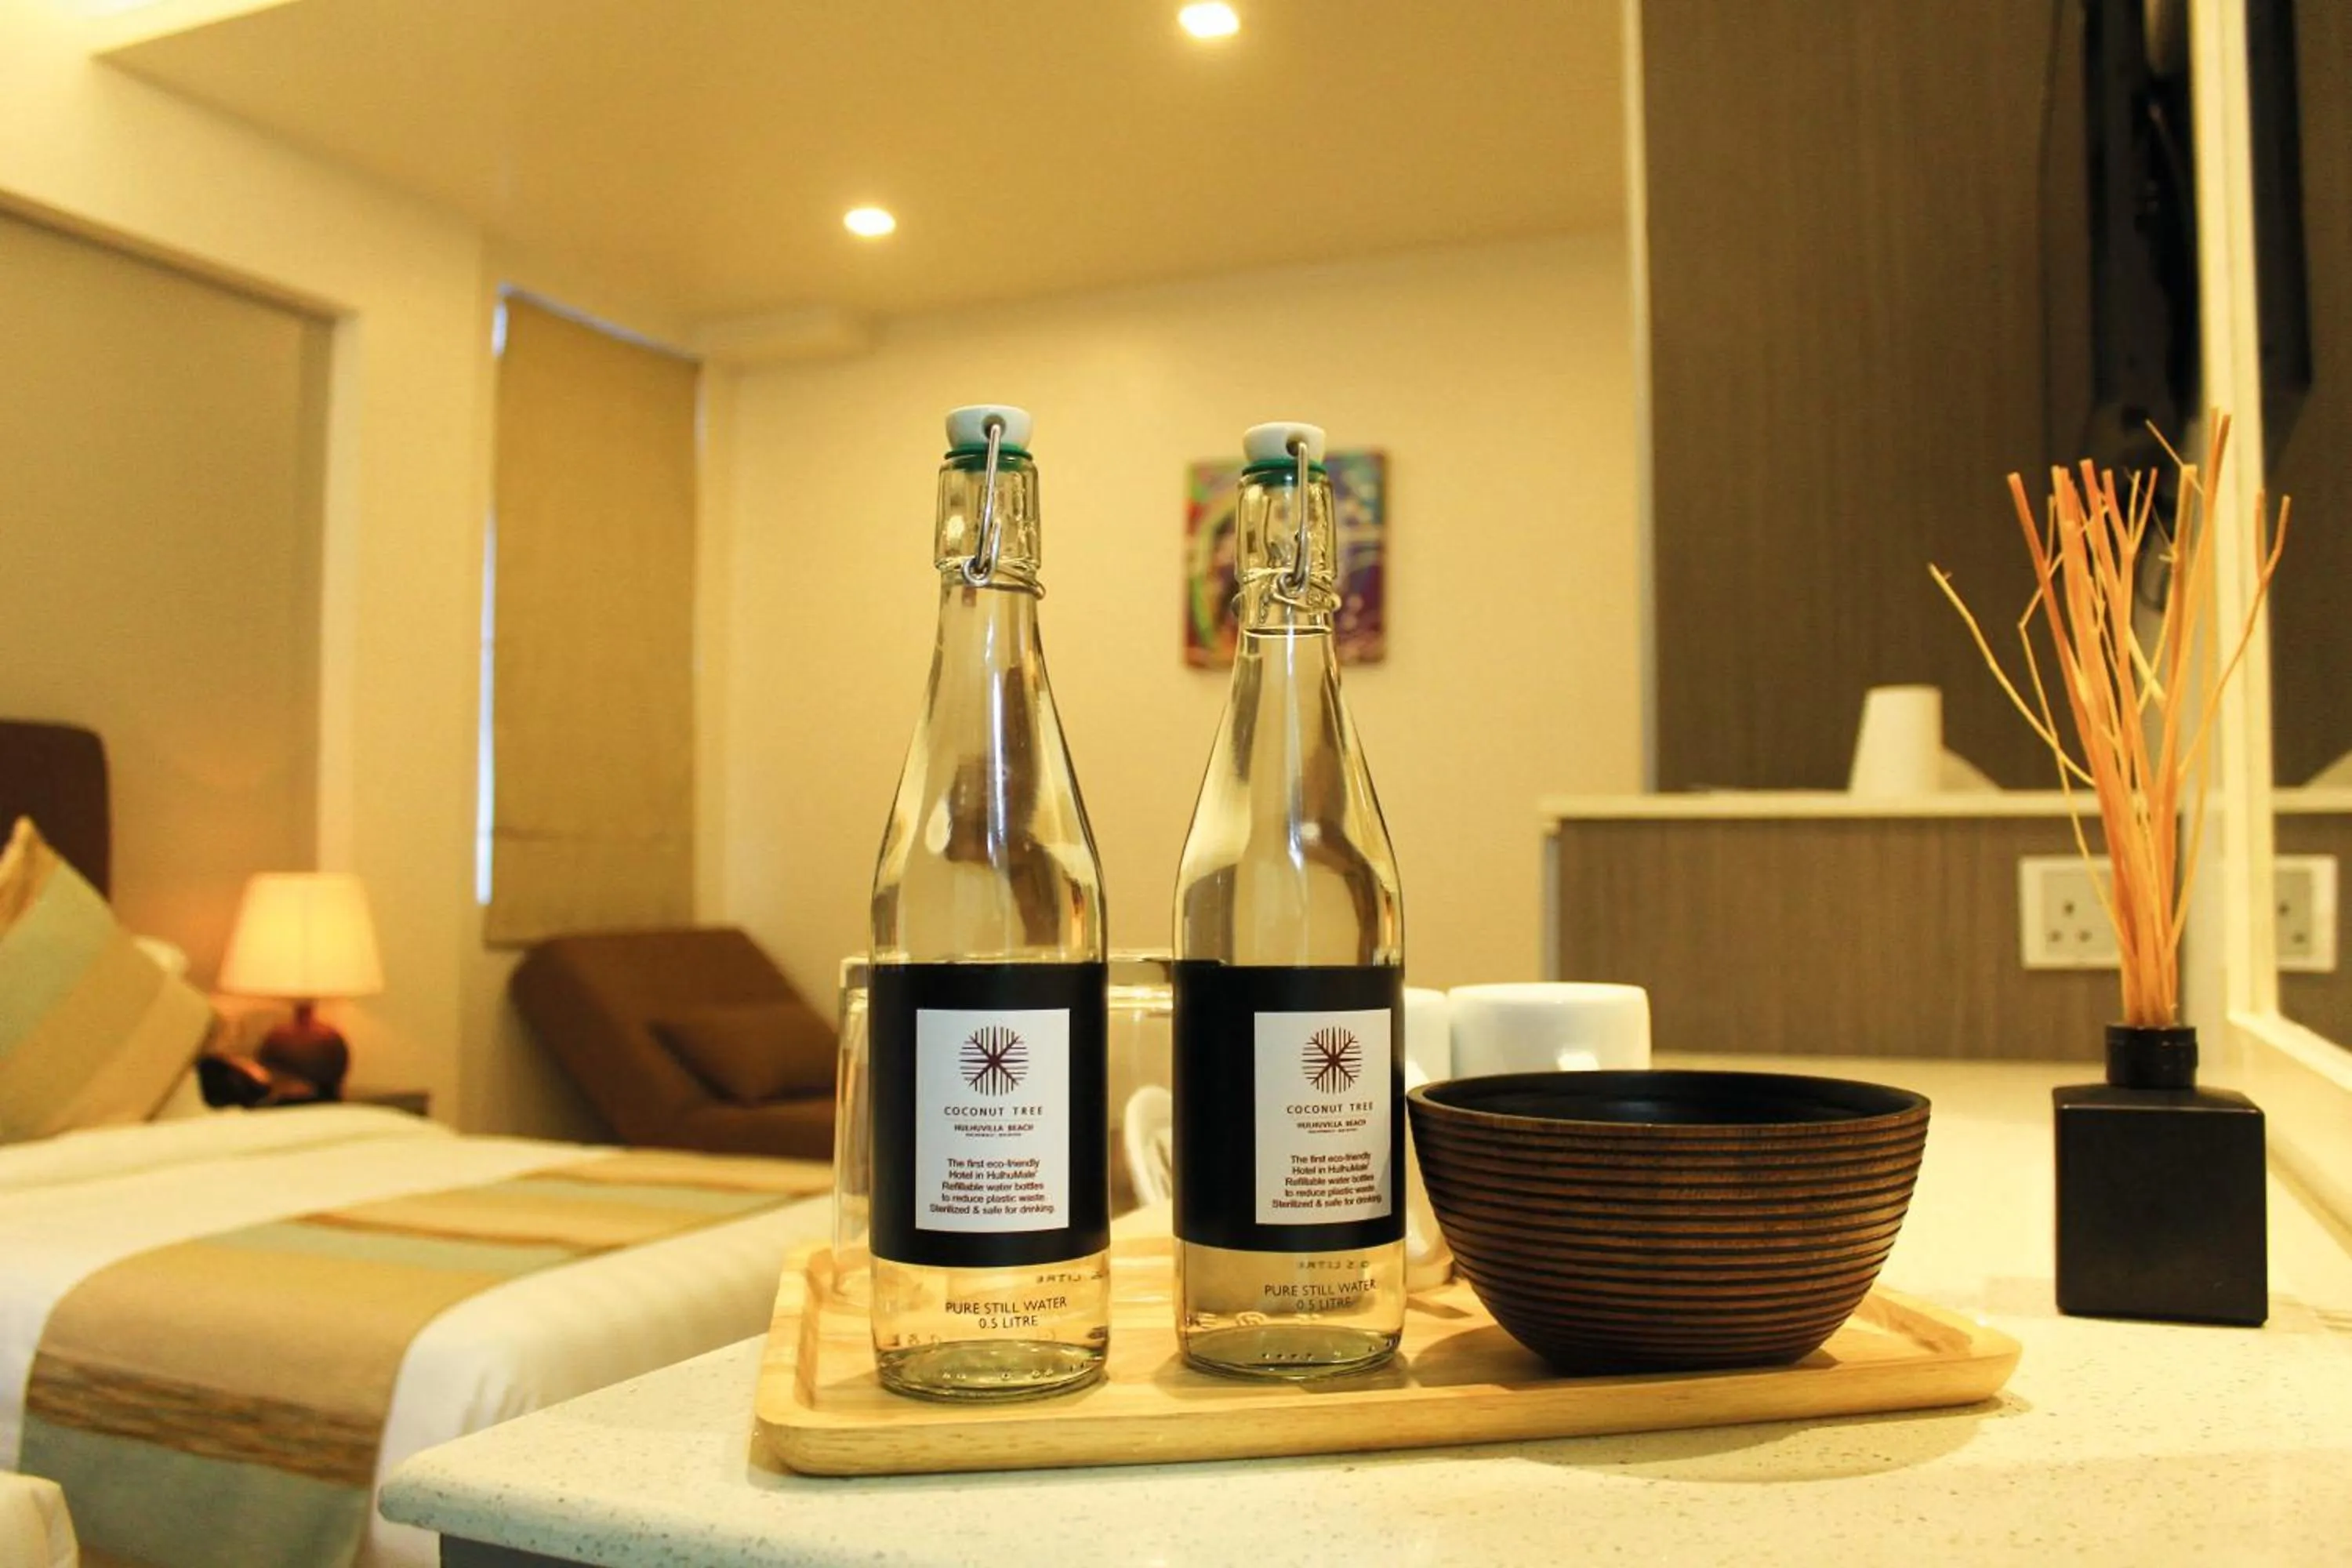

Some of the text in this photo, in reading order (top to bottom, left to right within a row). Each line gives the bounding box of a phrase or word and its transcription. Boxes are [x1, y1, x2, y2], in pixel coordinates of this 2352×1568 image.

[944, 1106, 1044, 1116] COCONUT TREE
[1287, 1102, 1374, 1114] COCONUT TREE
[947, 1158, 1040, 1168] The first eco-friendly
[1290, 1155, 1308, 1163] The
[1310, 1155, 1326, 1163] first
[949, 1171, 972, 1179] Hotel
[975, 1171, 984, 1179] in
[1292, 1166, 1316, 1174] Hotel
[942, 1181, 1044, 1191] Refillable water bottles
[1285, 1177, 1326, 1186] Refillable
[1327, 1176, 1350, 1185] water
[942, 1192, 950, 1202] to
[952, 1193, 983, 1203] reduce
[986, 1193, 1017, 1204] plastic
[1285, 1189, 1294, 1197] to
[1296, 1189, 1326, 1198] reduce
[1327, 1187, 1353, 1197] plastic
[1272, 1198, 1313, 1208] Sterilized
[1316, 1199, 1323, 1207] &
[1324, 1197, 1343, 1208] safe
[1345, 1196, 1354, 1205] for
[929, 1203, 970, 1214] Sterilized
[973, 1206, 981, 1214] &
[982, 1205, 1003, 1214] safe
[1004, 1205, 1018, 1214] for
[1265, 1279, 1376, 1297] PURE STILL WATER
[946, 1296, 1067, 1315] PURE STILL WATER
[1296, 1297, 1352, 1311] 05 LITRE
[978, 1316, 1039, 1329] 0.5 LITRE
